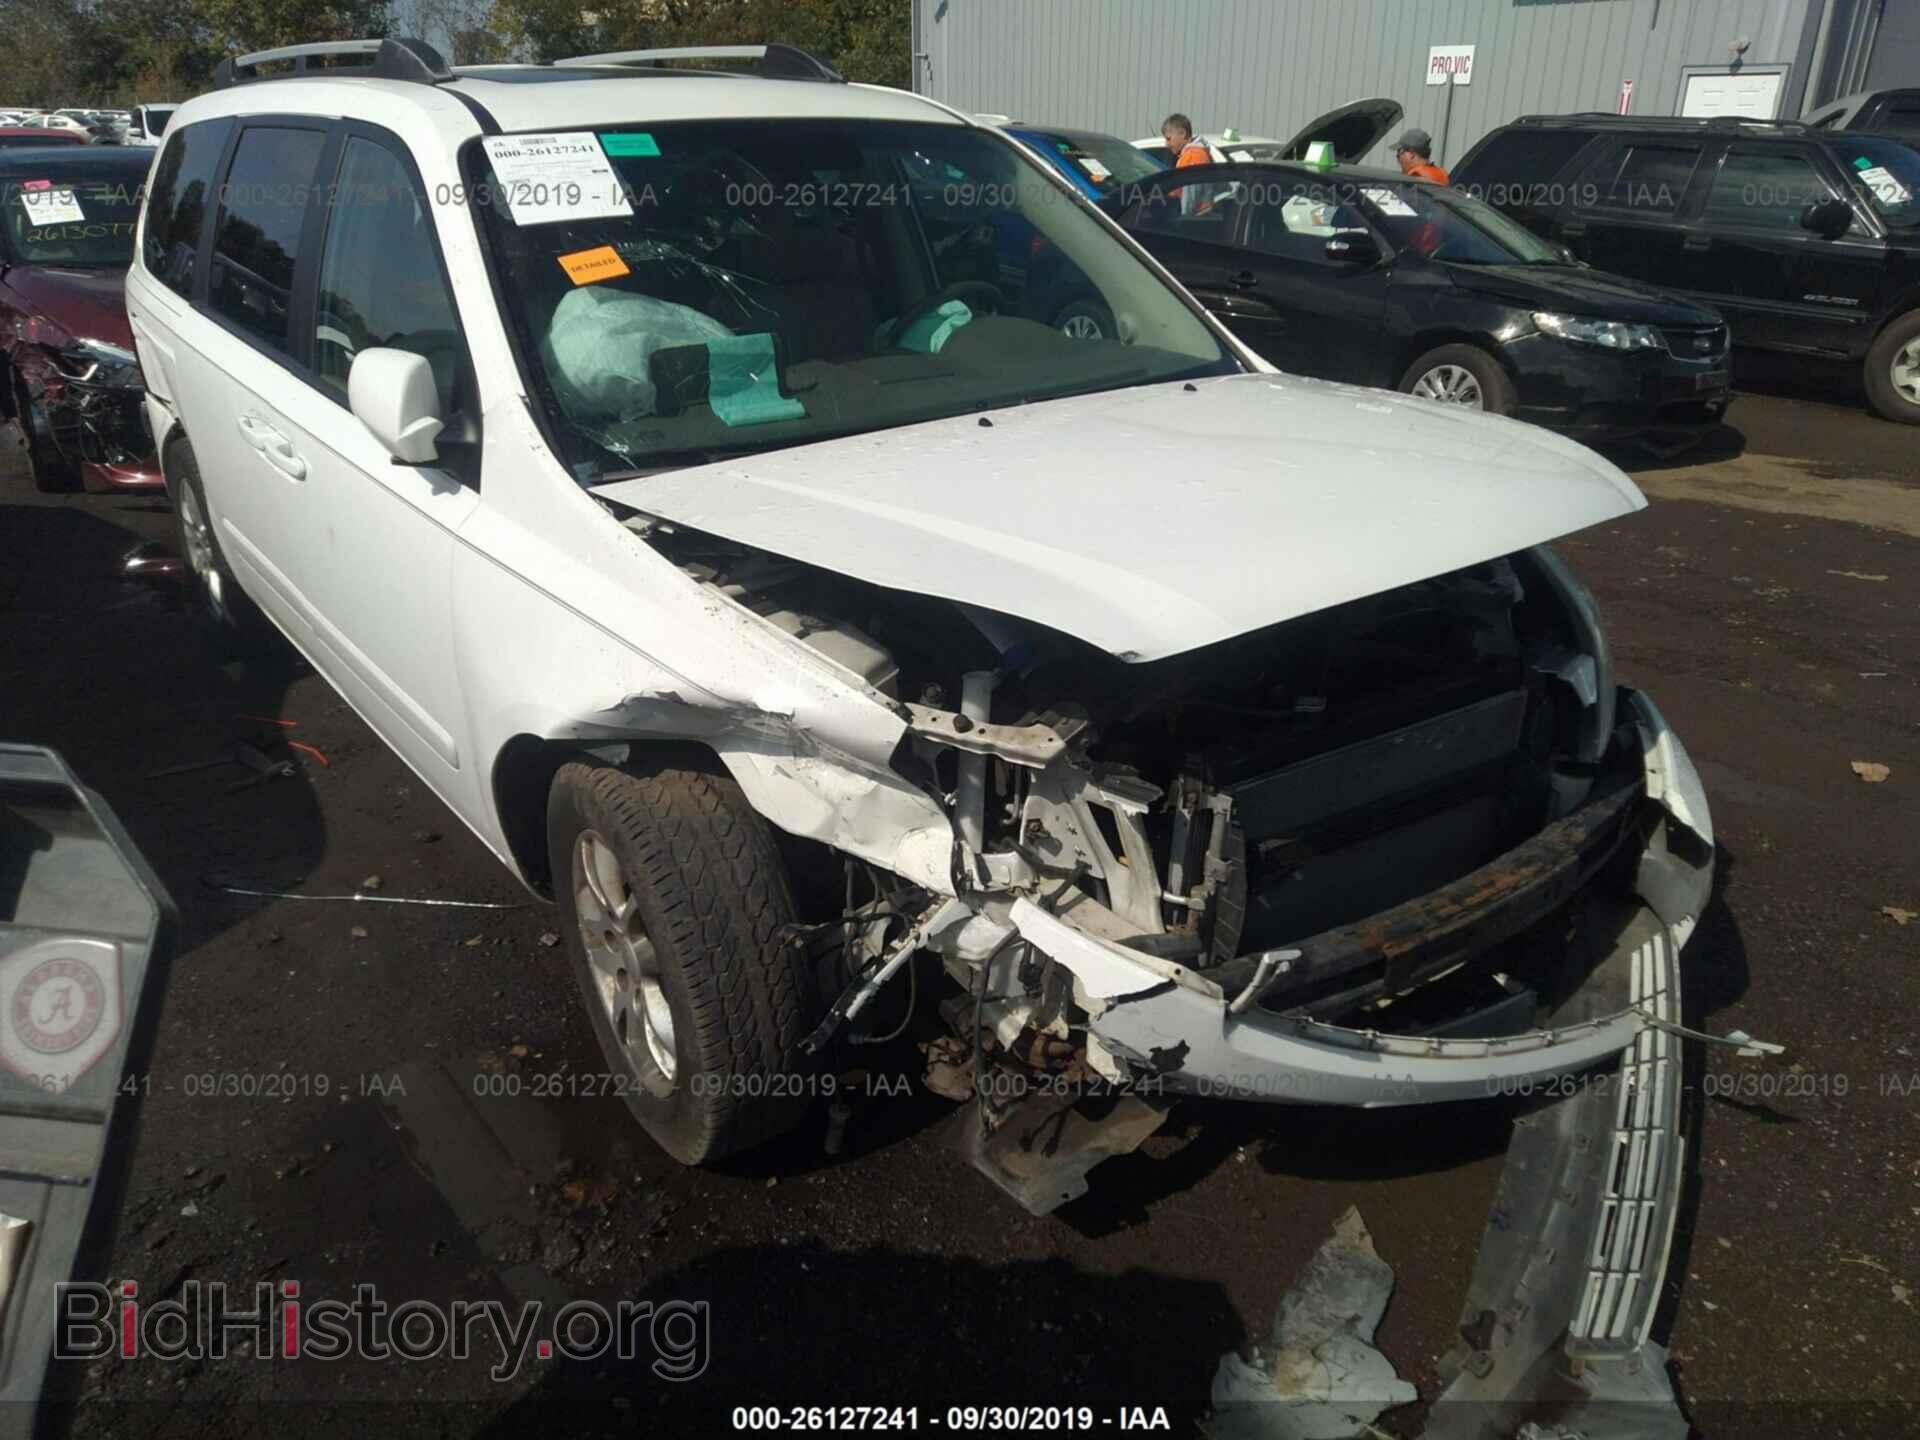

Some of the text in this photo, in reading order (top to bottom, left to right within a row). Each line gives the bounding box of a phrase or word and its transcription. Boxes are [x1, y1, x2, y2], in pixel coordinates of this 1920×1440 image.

[1431, 55, 1471, 74] PRO VIC
[494, 144, 595, 160] 000-26127241
